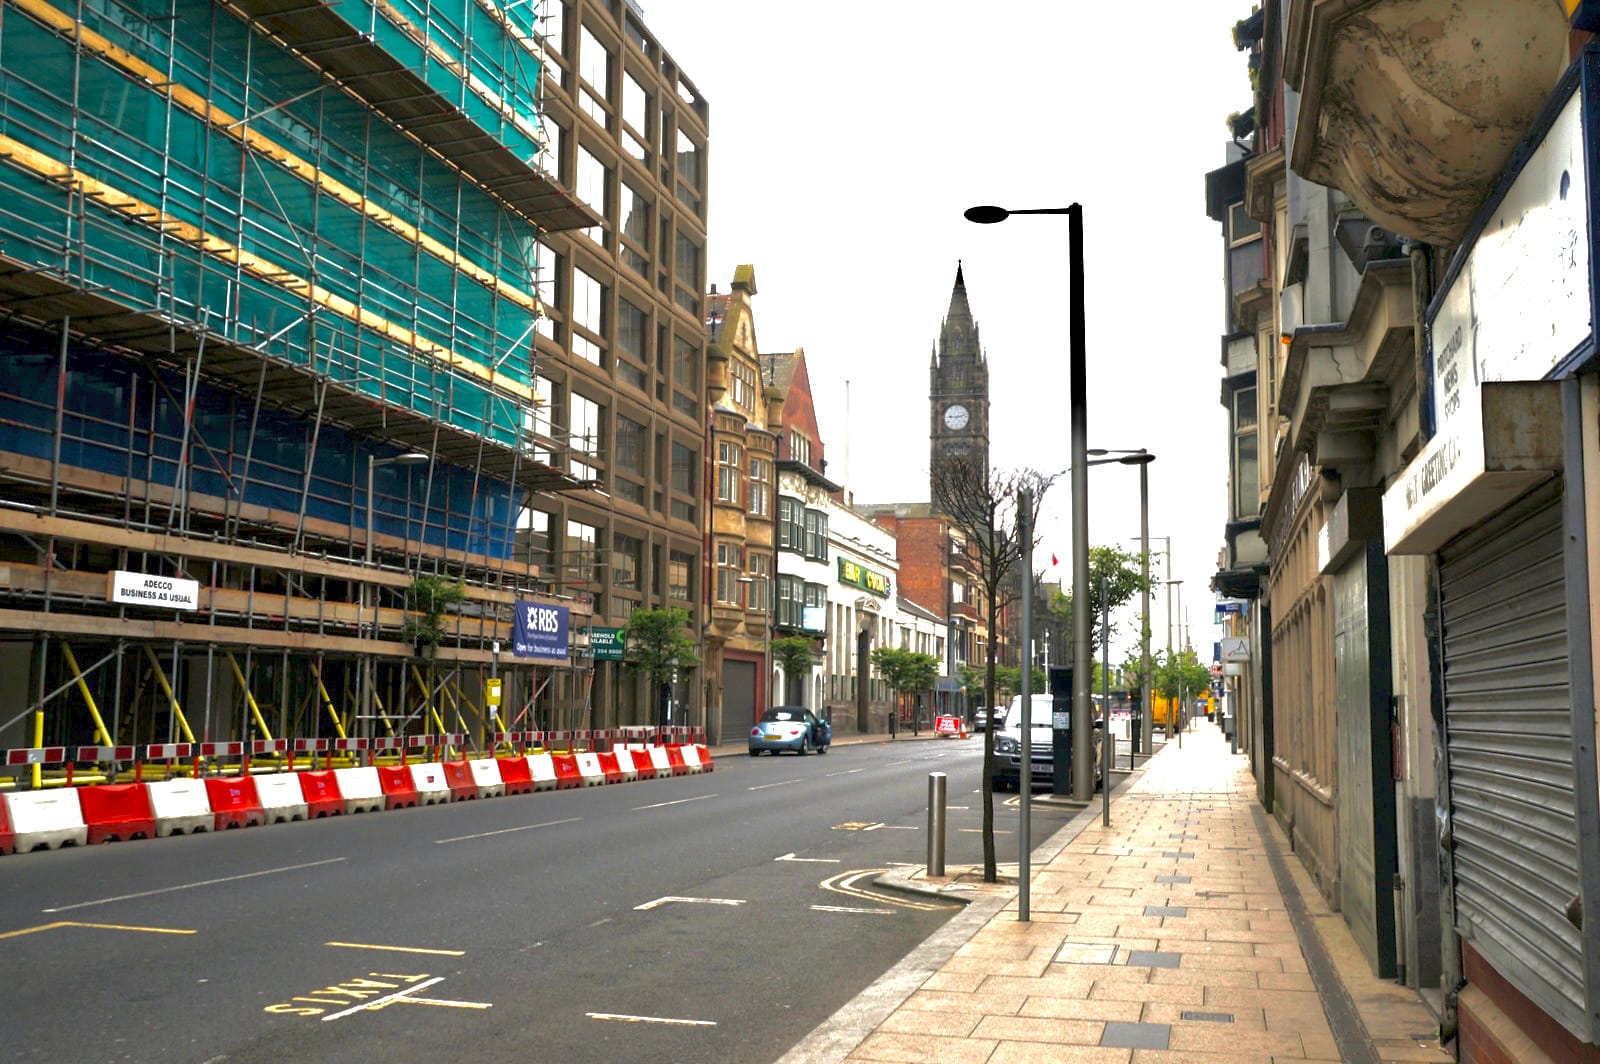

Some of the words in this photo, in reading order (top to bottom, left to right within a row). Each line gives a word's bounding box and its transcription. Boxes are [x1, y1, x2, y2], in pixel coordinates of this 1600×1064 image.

[1443, 362, 1458, 397] NEWS
[143, 579, 172, 590] ADECCO
[120, 588, 157, 600] BUSINESS
[158, 593, 168, 601] AS
[169, 594, 192, 604] USUAL
[538, 608, 559, 633] RBS
[516, 642, 527, 653] Open
[263, 972, 431, 1016] TAXIS
